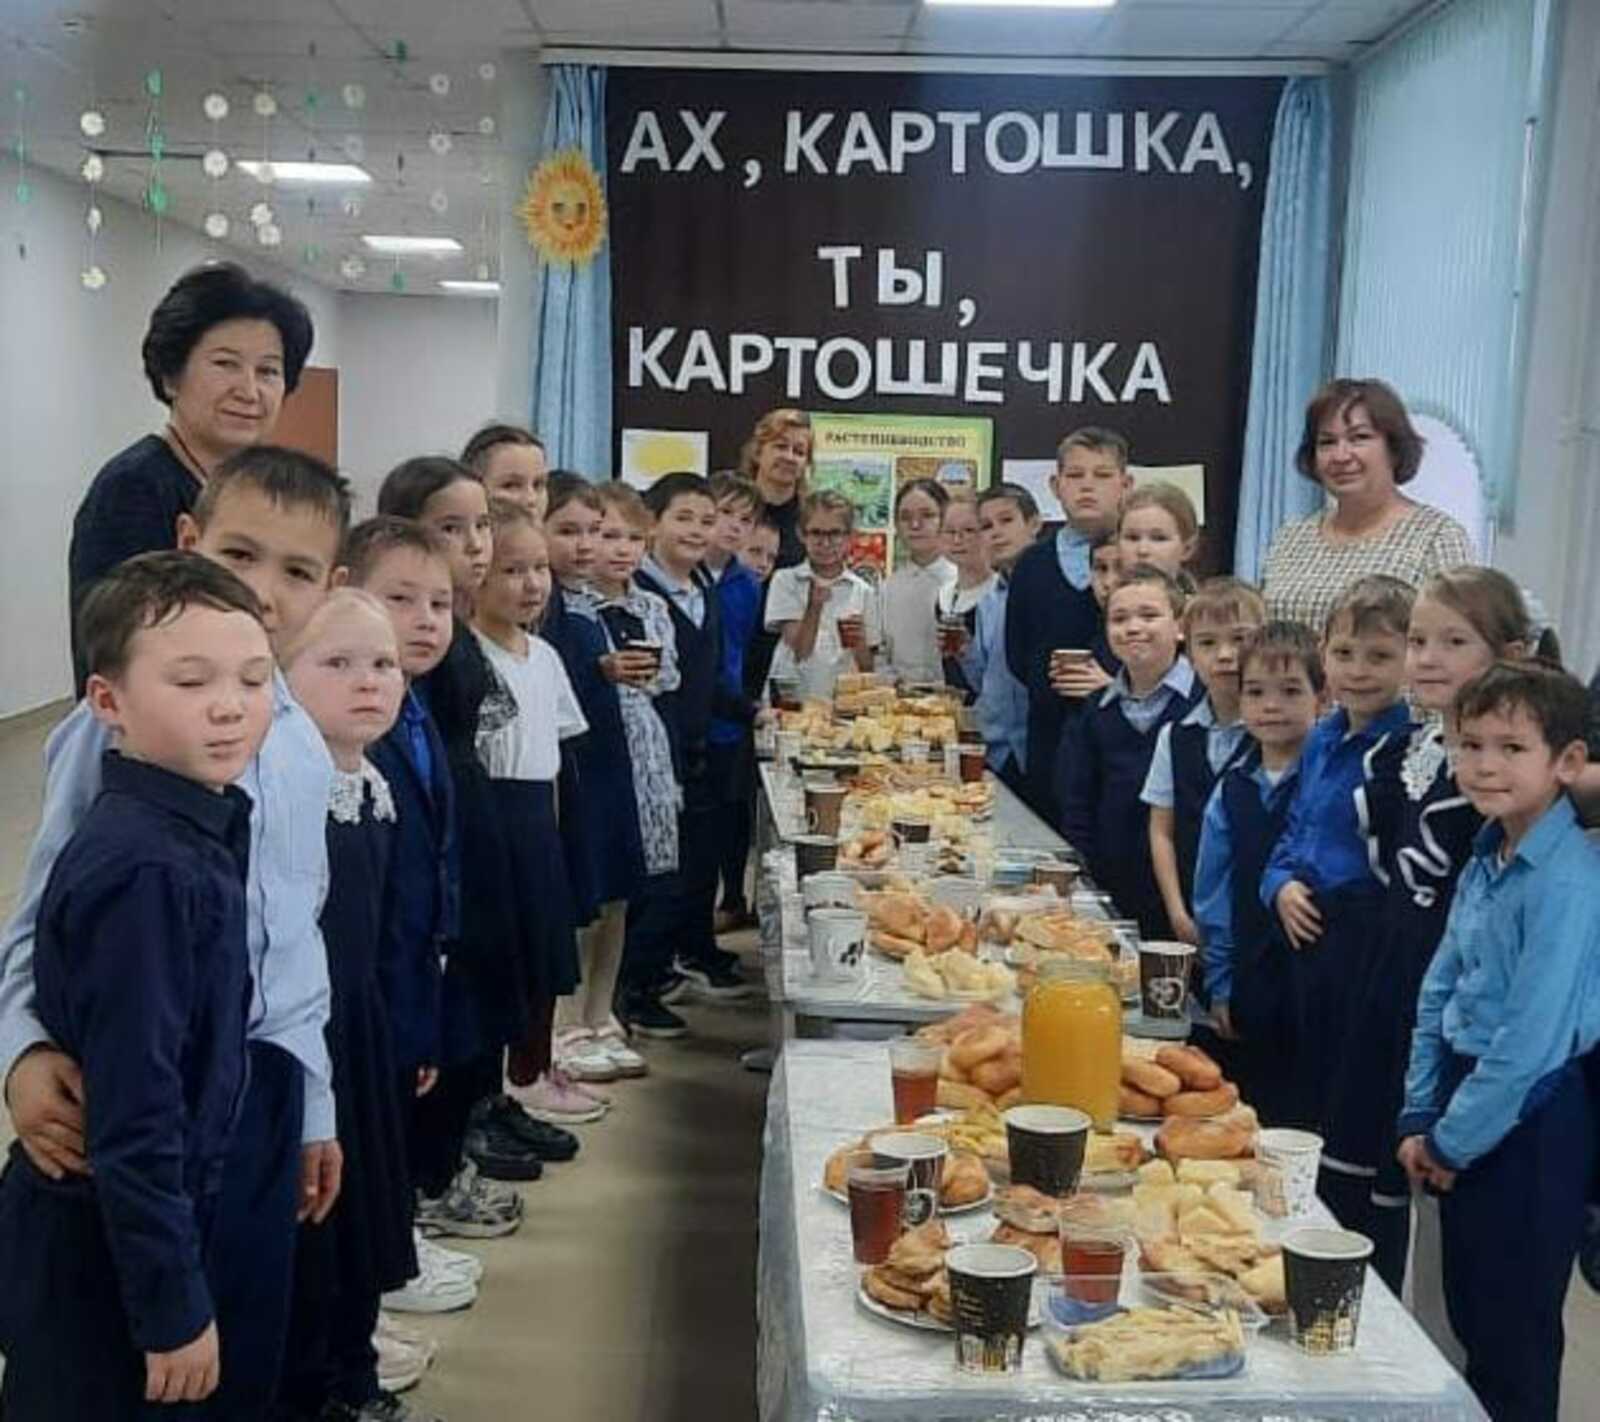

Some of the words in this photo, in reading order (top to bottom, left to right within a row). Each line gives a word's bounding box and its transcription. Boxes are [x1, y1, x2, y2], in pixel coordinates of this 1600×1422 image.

[621, 111, 761, 187] АХ,
[784, 111, 1252, 188] КАРТОШКА,
[818, 246, 976, 327] ТЫ,
[628, 327, 1171, 403] КАРТОШЕЧКА
